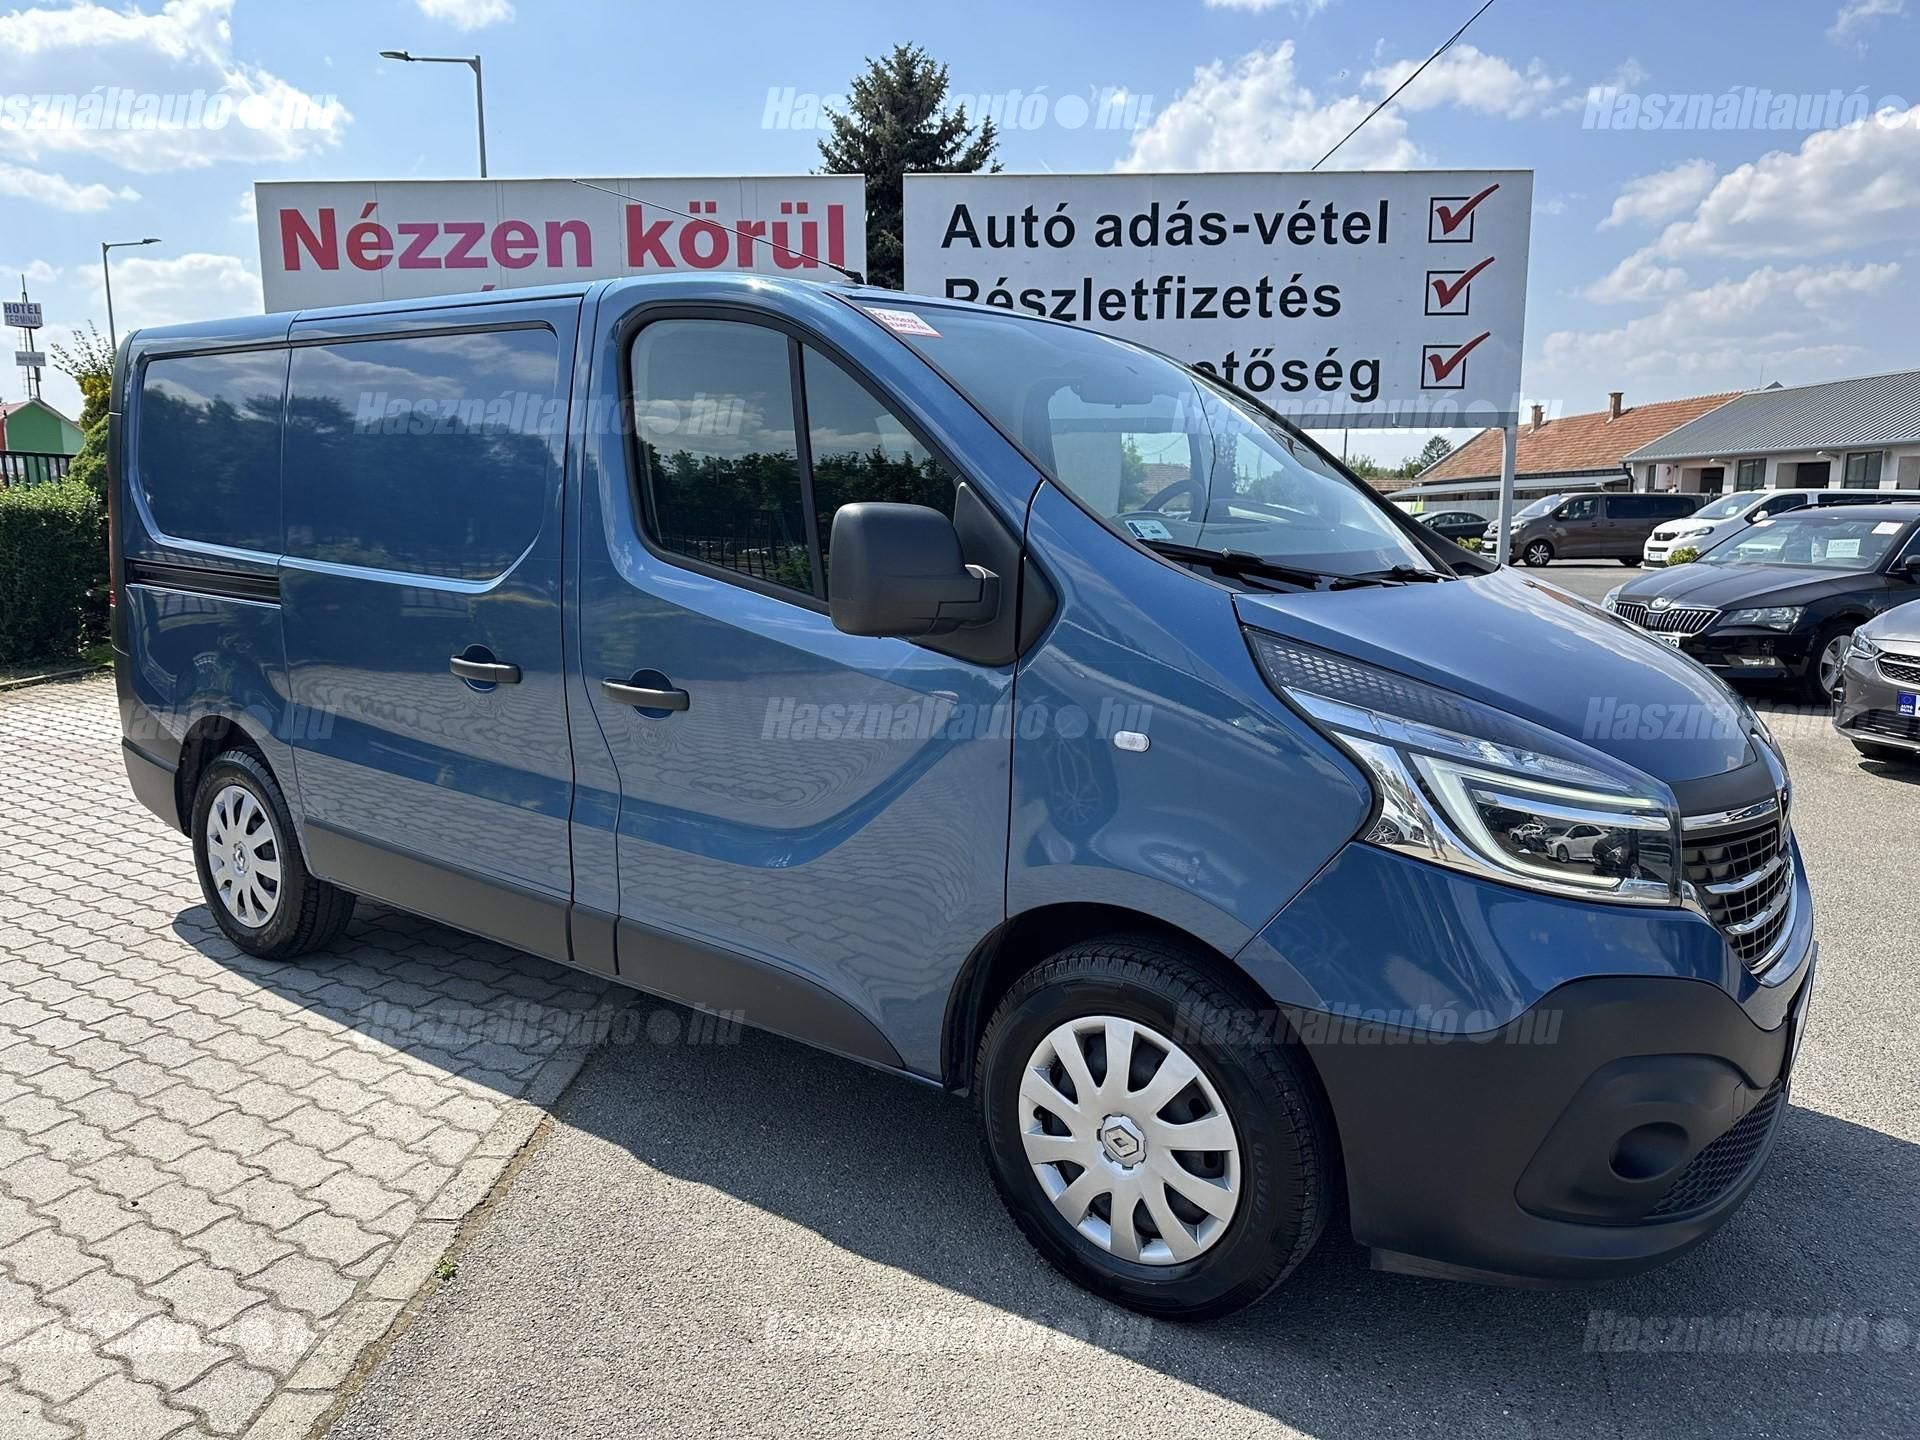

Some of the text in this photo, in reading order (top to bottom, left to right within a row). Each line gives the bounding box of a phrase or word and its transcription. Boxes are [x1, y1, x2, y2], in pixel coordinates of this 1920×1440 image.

[279, 201, 845, 271] Nézzen körül
[941, 200, 1389, 249] Autó adás-vétel
[4, 303, 41, 314] HOTEL
[5, 314, 42, 325] TERMINAL
[945, 273, 1342, 322] Részletfizetés
